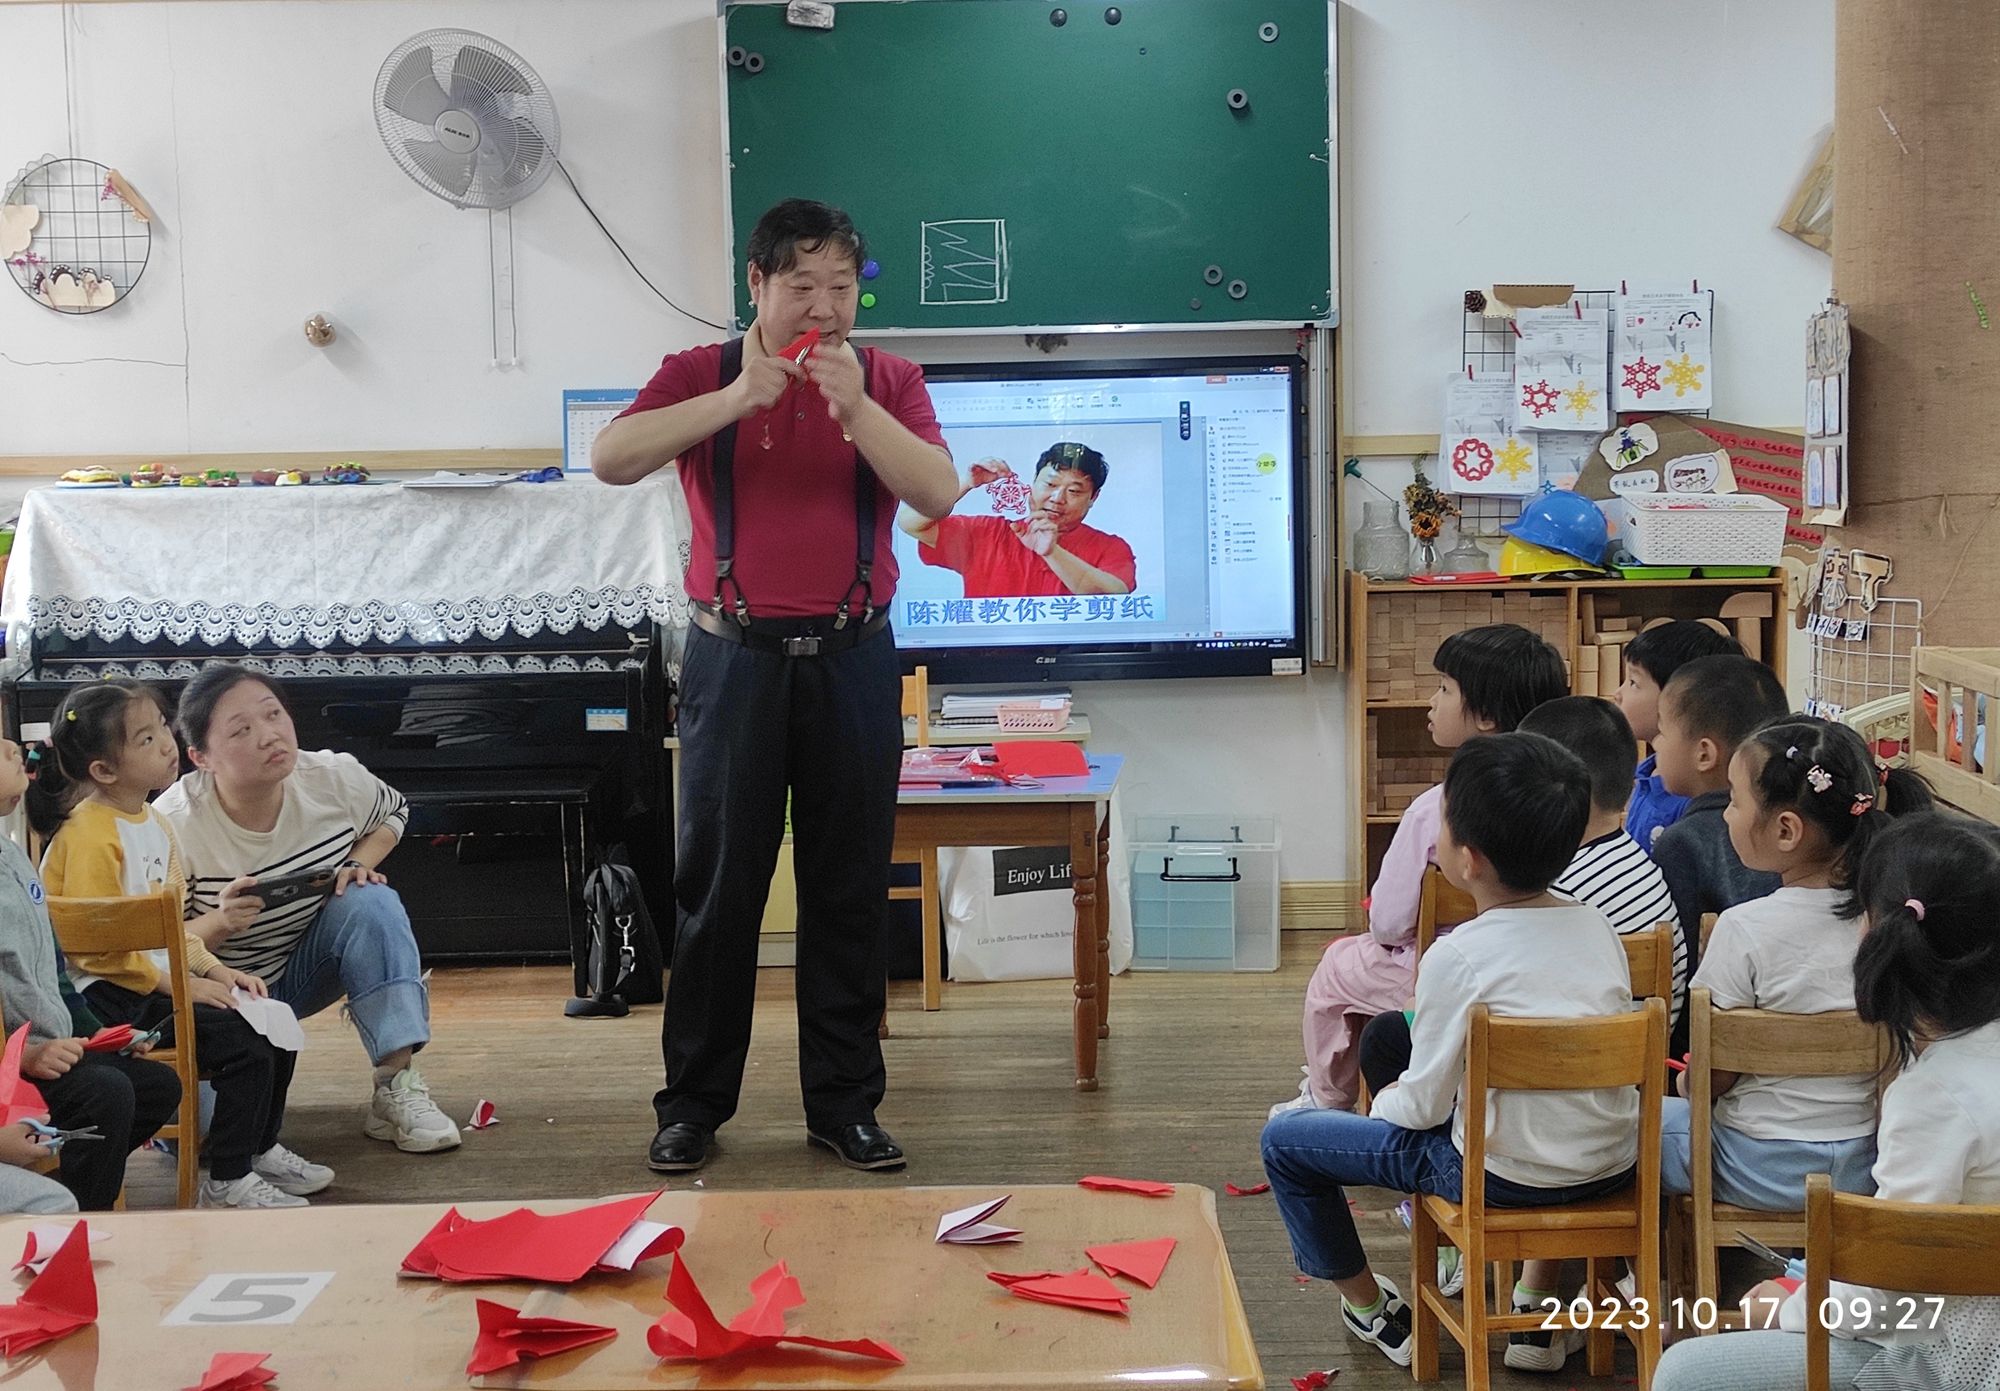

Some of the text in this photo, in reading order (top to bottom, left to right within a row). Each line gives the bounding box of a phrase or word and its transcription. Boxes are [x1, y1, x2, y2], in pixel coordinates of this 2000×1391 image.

[906, 594, 1155, 626] 陈耀教你学剪纸
[1007, 863, 1072, 886] Enjoy Lif
[996, 935, 1006, 943] the
[1007, 934, 1028, 942] flower
[1028, 932, 1039, 940] for
[1040, 931, 1060, 939] which
[188, 1276, 309, 1323] 5
